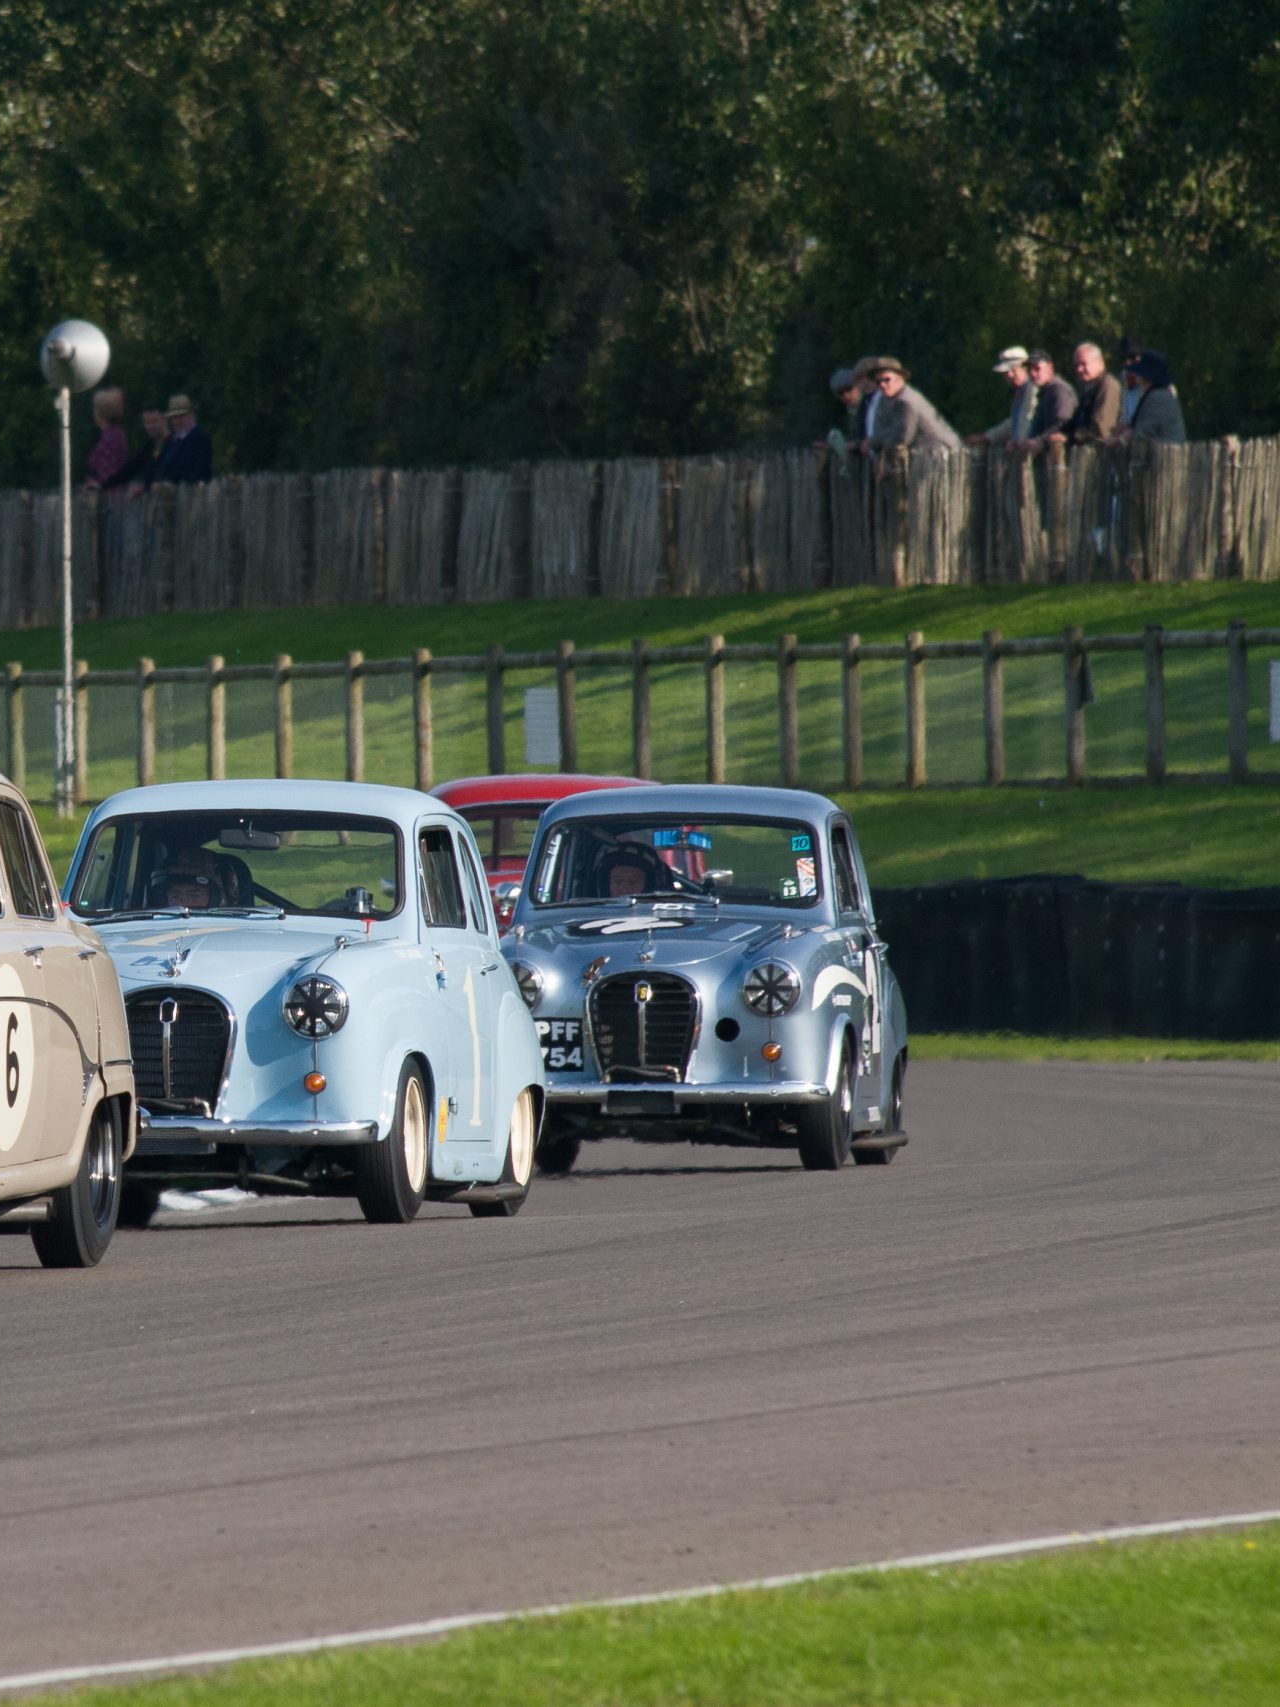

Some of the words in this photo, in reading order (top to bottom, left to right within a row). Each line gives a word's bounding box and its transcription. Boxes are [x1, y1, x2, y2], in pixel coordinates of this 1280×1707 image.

[793, 837, 809, 849] 10
[783, 886, 797, 897] 13
[535, 1021, 580, 1041] PFF
[463, 964, 482, 1126] 1
[6, 1012, 20, 1108] 6
